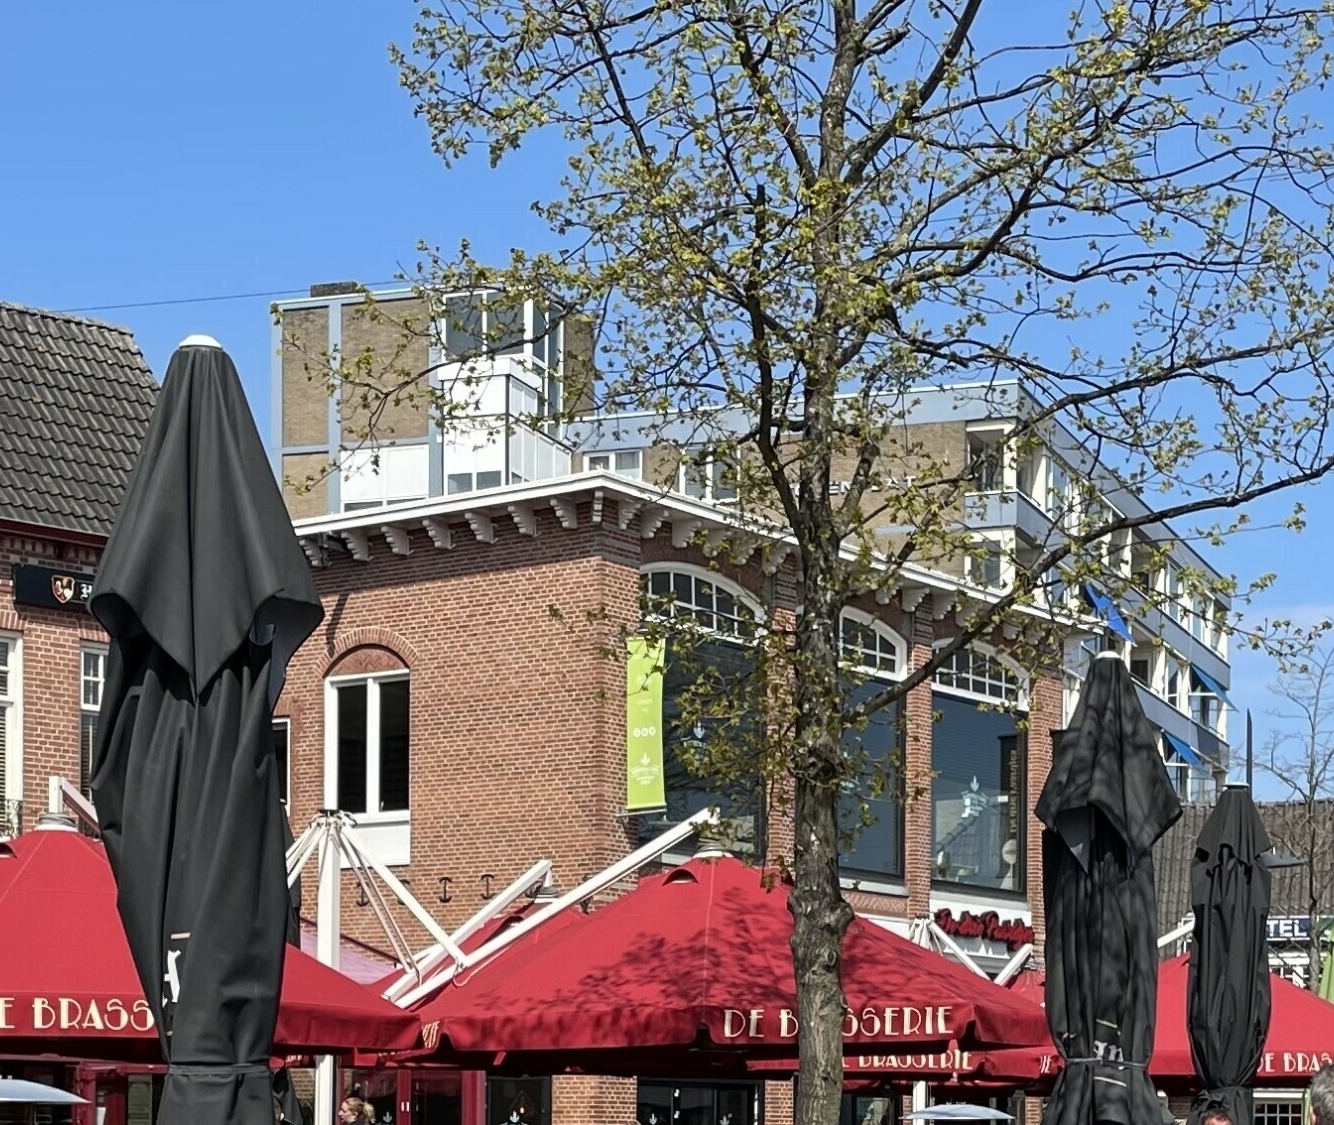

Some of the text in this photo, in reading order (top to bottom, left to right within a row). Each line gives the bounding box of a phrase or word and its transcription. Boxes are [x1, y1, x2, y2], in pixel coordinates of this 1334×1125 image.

[1266, 919, 1307, 937] TEL
[32, 997, 154, 1031] BRASS
[723, 1005, 954, 1038] DE BSSERIE
